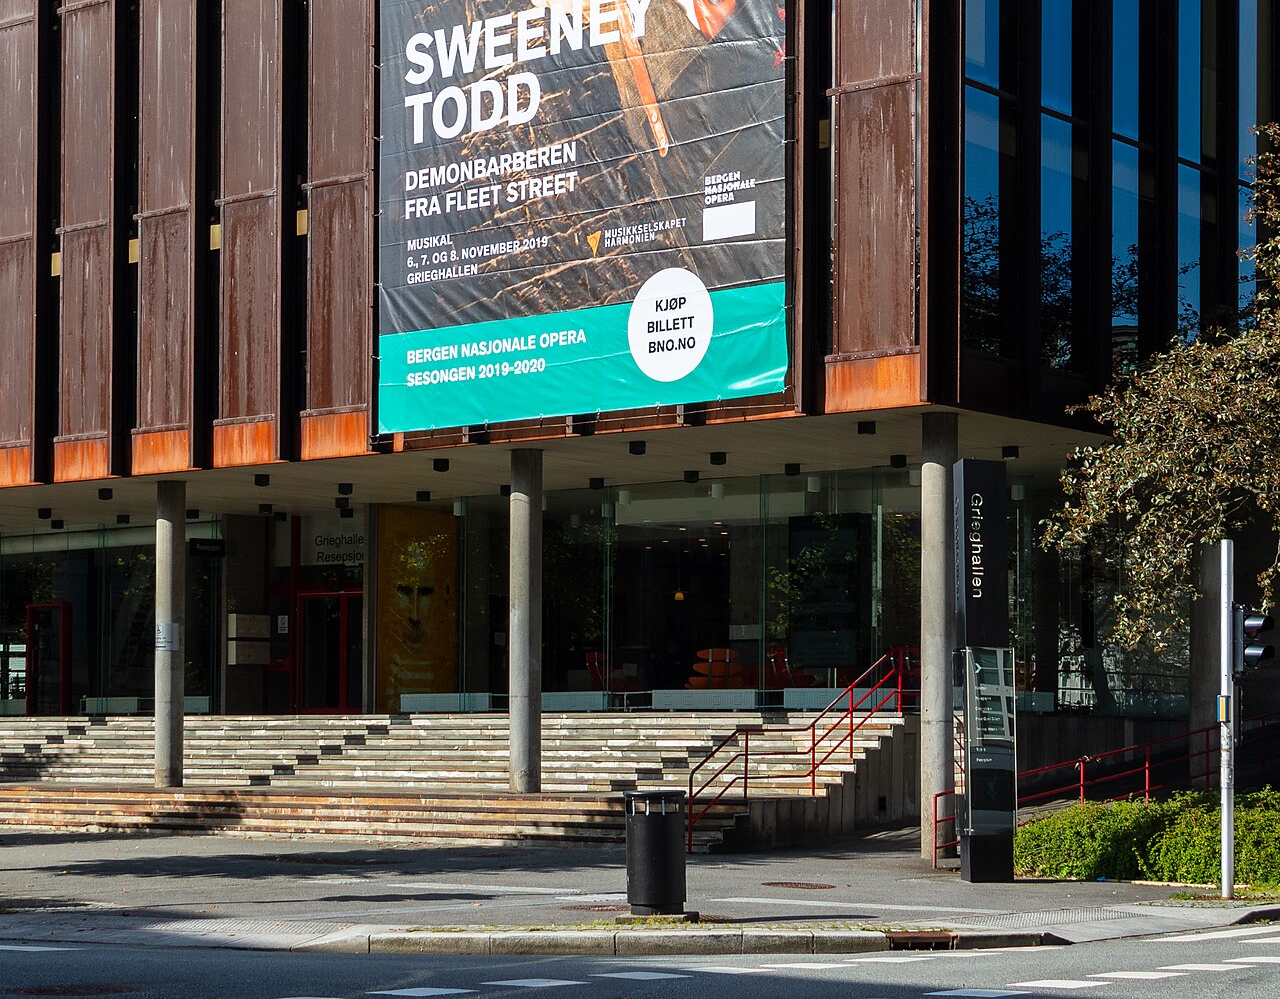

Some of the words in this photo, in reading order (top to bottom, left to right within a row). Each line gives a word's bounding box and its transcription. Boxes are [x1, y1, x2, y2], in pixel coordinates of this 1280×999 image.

[405, 72, 541, 145] TODD
[405, 142, 576, 191] DEMONBARBEREN
[704, 171, 741, 186] BERGEN
[704, 178, 756, 196] NASJONALE
[405, 195, 441, 220] FRA
[446, 184, 502, 213] FLEET
[506, 171, 578, 202] STREET
[704, 192, 735, 205] OPERA
[604, 217, 687, 238] MUSIKKSELSKAPET
[407, 234, 453, 251] MUSIKAL
[604, 231, 655, 248] HARMONIEN
[407, 256, 419, 269] 6.,
[421, 254, 430, 266] 7.
[432, 252, 448, 264] OG
[450, 250, 459, 262] 8.
[462, 240, 521, 260] NOVEMBER
[522, 236, 549, 251] 2019
[407, 263, 478, 284] GRIEGHALLEN
[655, 297, 687, 312] KJØP
[647, 316, 695, 333] BILLETT
[407, 345, 458, 364] BERGEN
[461, 335, 536, 358] NASJONALE
[539, 329, 587, 348] OPERA
[648, 336, 696, 353] BNO.NO
[407, 366, 476, 387] SESONGEN
[479, 358, 546, 379] 2019-2020
[314, 534, 364, 548] Grieghalle
[969, 493, 985, 598] Grieghallen
